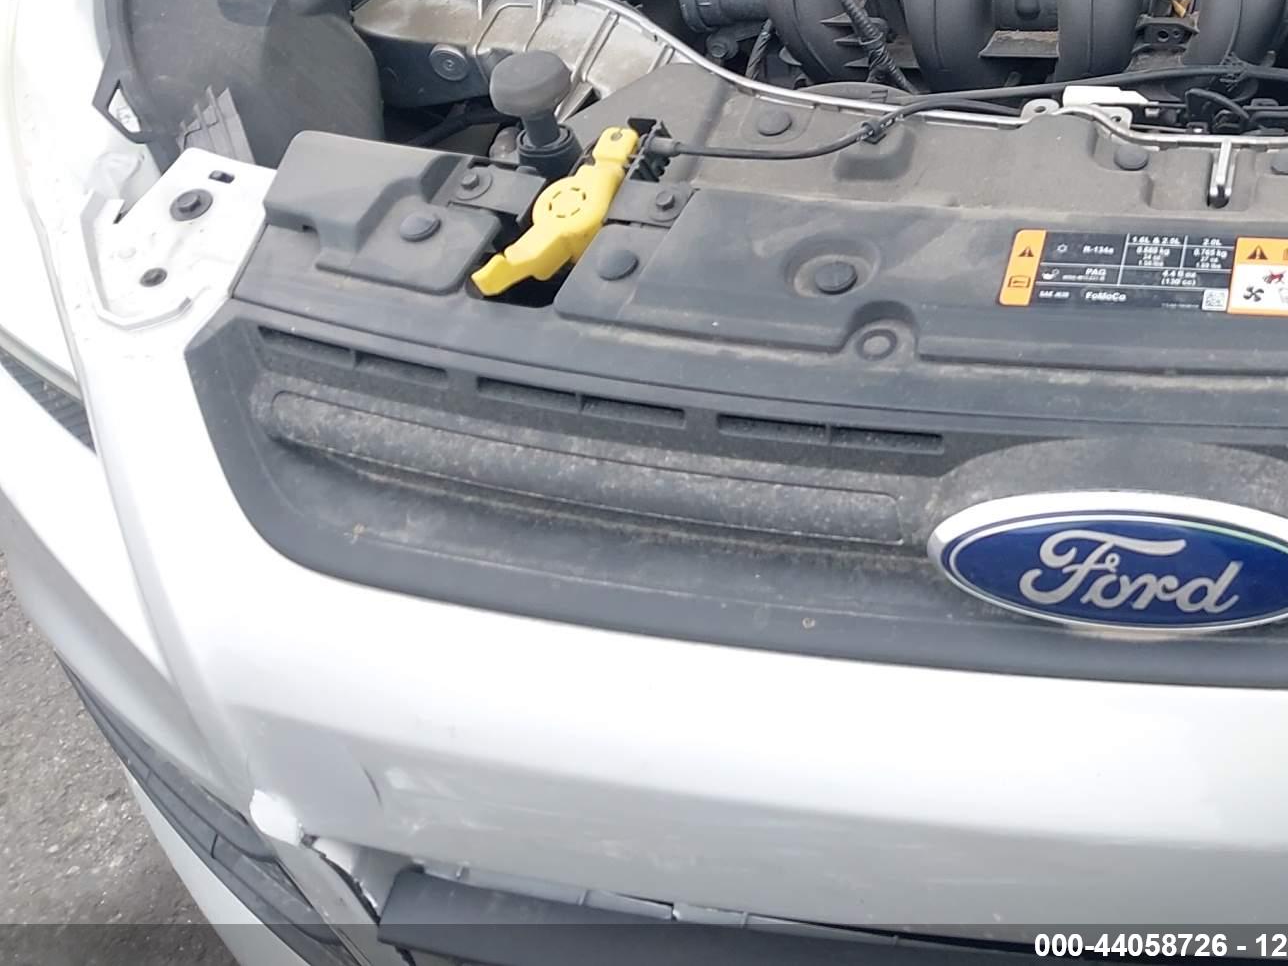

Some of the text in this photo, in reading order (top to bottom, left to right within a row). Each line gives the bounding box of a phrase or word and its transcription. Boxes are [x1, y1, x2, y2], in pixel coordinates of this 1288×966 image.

[1085, 267, 1107, 275] PAG
[1085, 290, 1127, 302] FoMoCo
[1019, 529, 1244, 614] Ford
